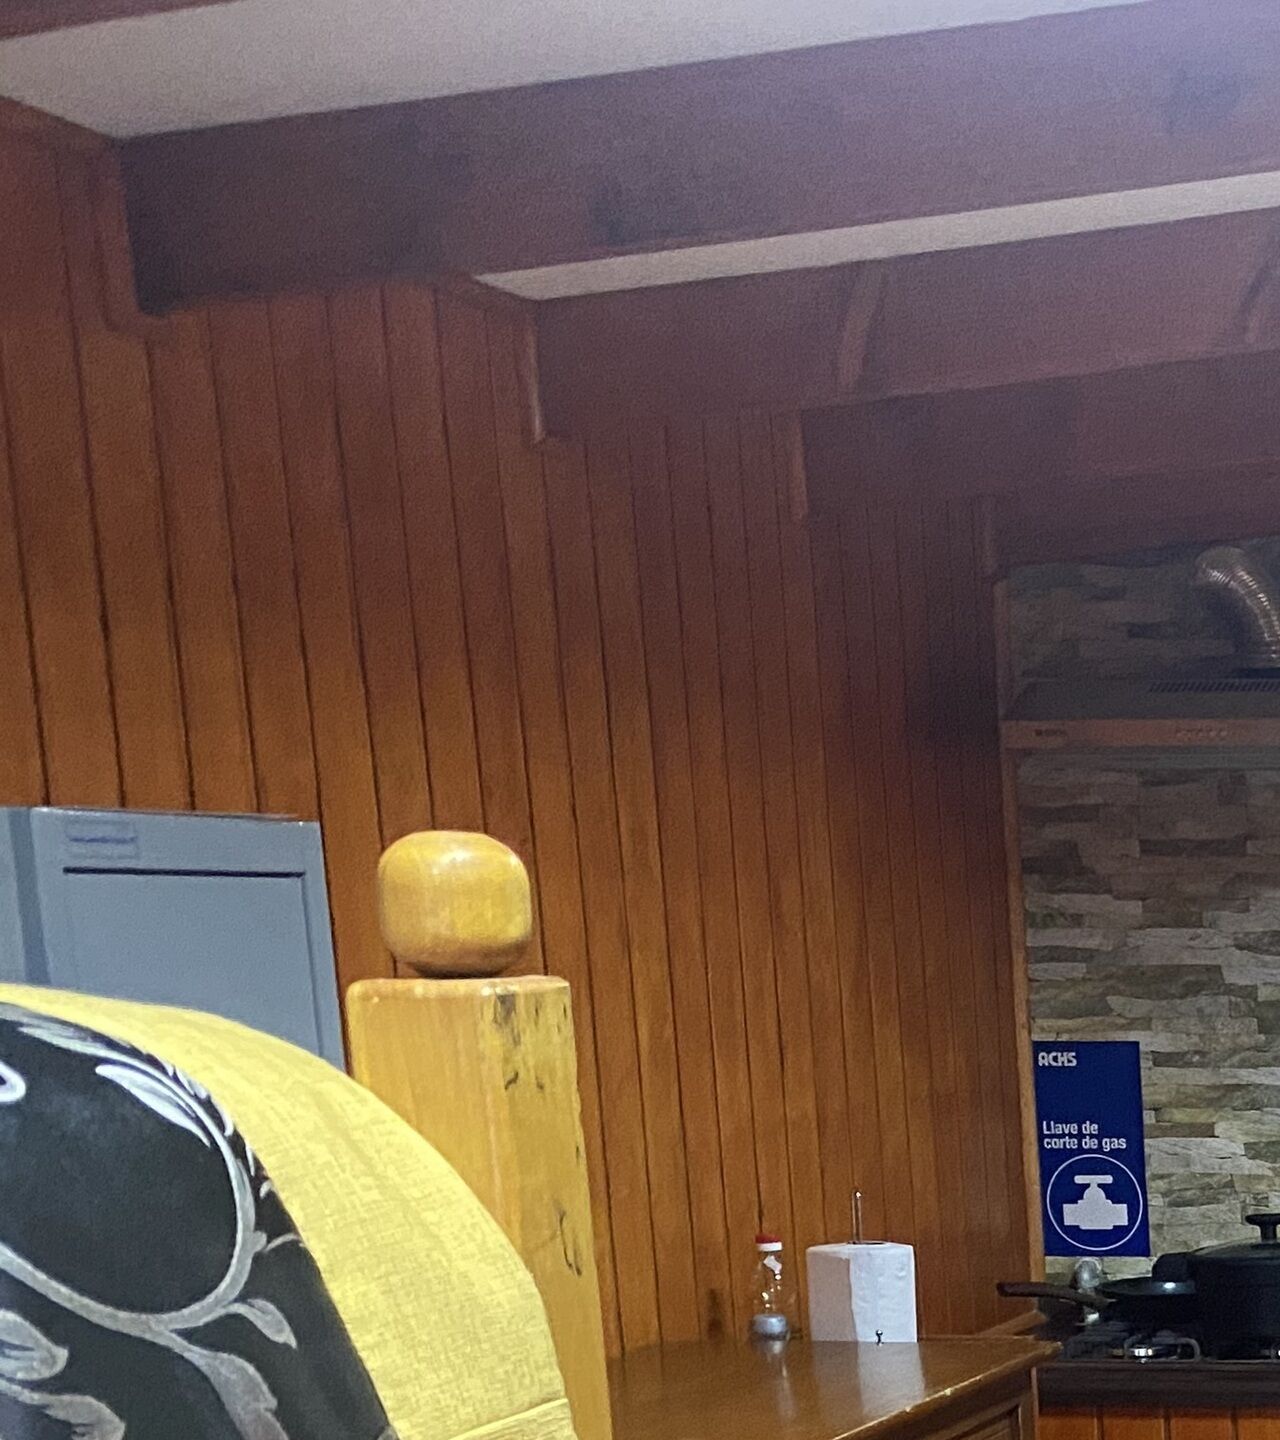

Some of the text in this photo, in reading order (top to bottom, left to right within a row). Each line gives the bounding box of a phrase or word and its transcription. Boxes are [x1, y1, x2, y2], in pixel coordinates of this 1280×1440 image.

[1038, 1052, 1077, 1067] ACHS
[1042, 1120, 1098, 1134] Llave de
[1043, 1135, 1127, 1152] corte de gas
